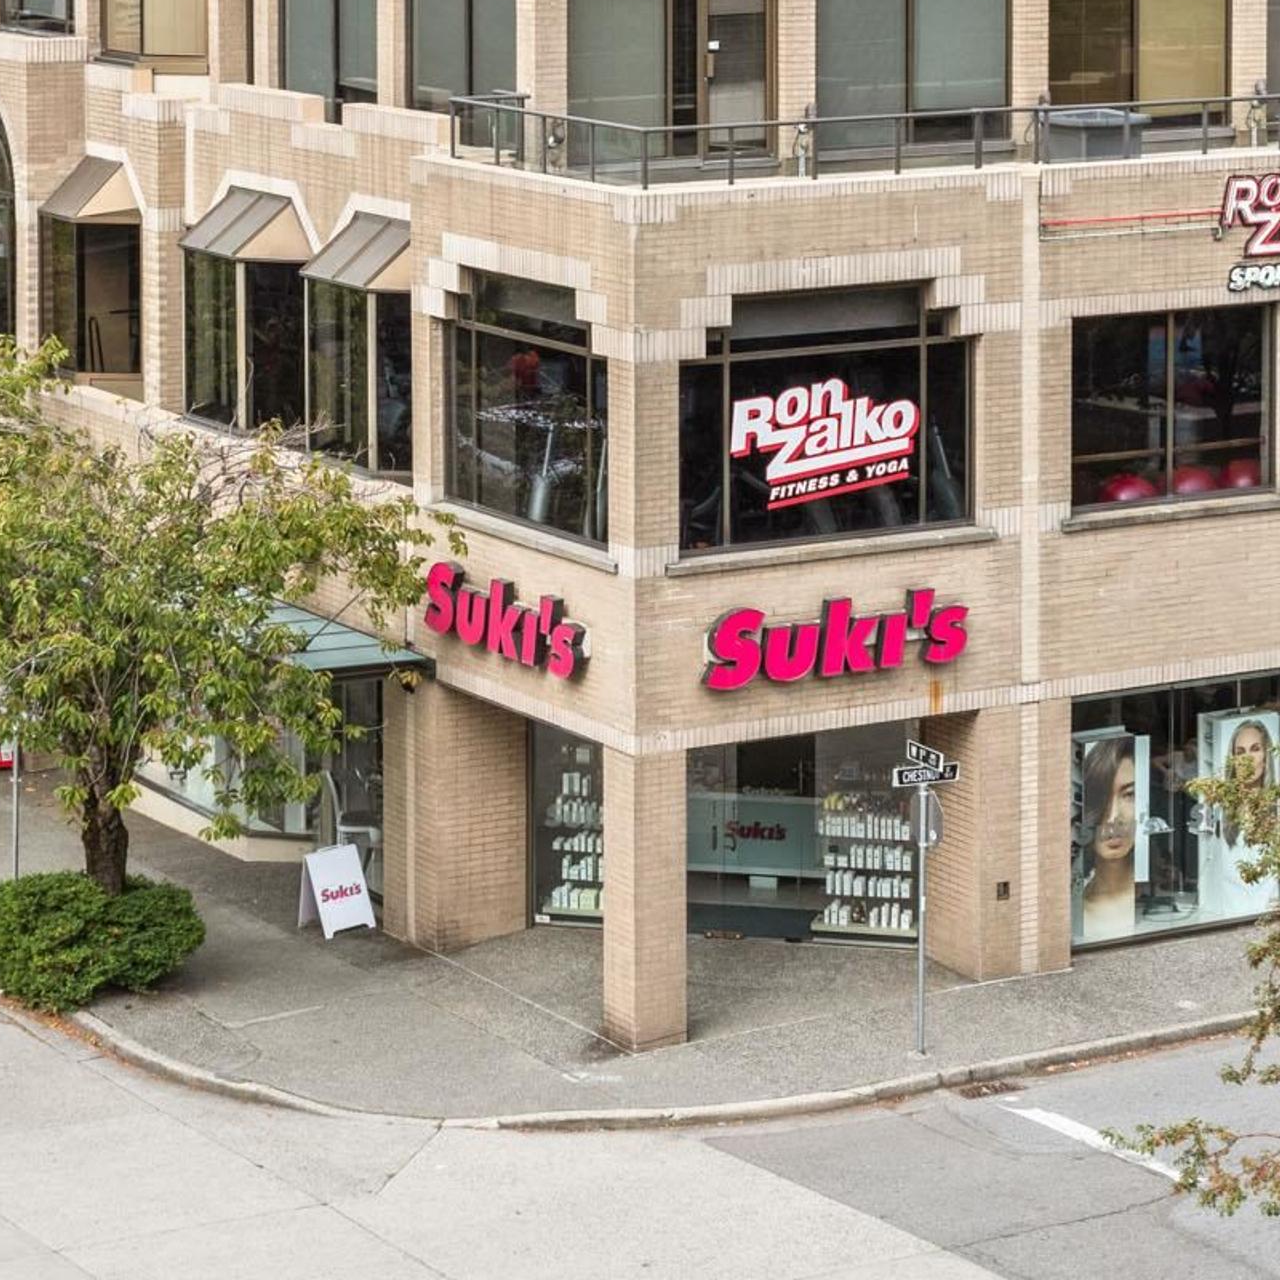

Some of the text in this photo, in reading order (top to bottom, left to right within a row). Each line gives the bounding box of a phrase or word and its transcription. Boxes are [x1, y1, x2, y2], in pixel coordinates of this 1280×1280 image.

[730, 378, 848, 457] Ron
[766, 396, 919, 483] Zalko
[770, 457, 909, 501] FITNESS & YOGA
[424, 561, 579, 680] Suki's
[704, 587, 970, 691] Suki's
[321, 882, 362, 903] Suki's
